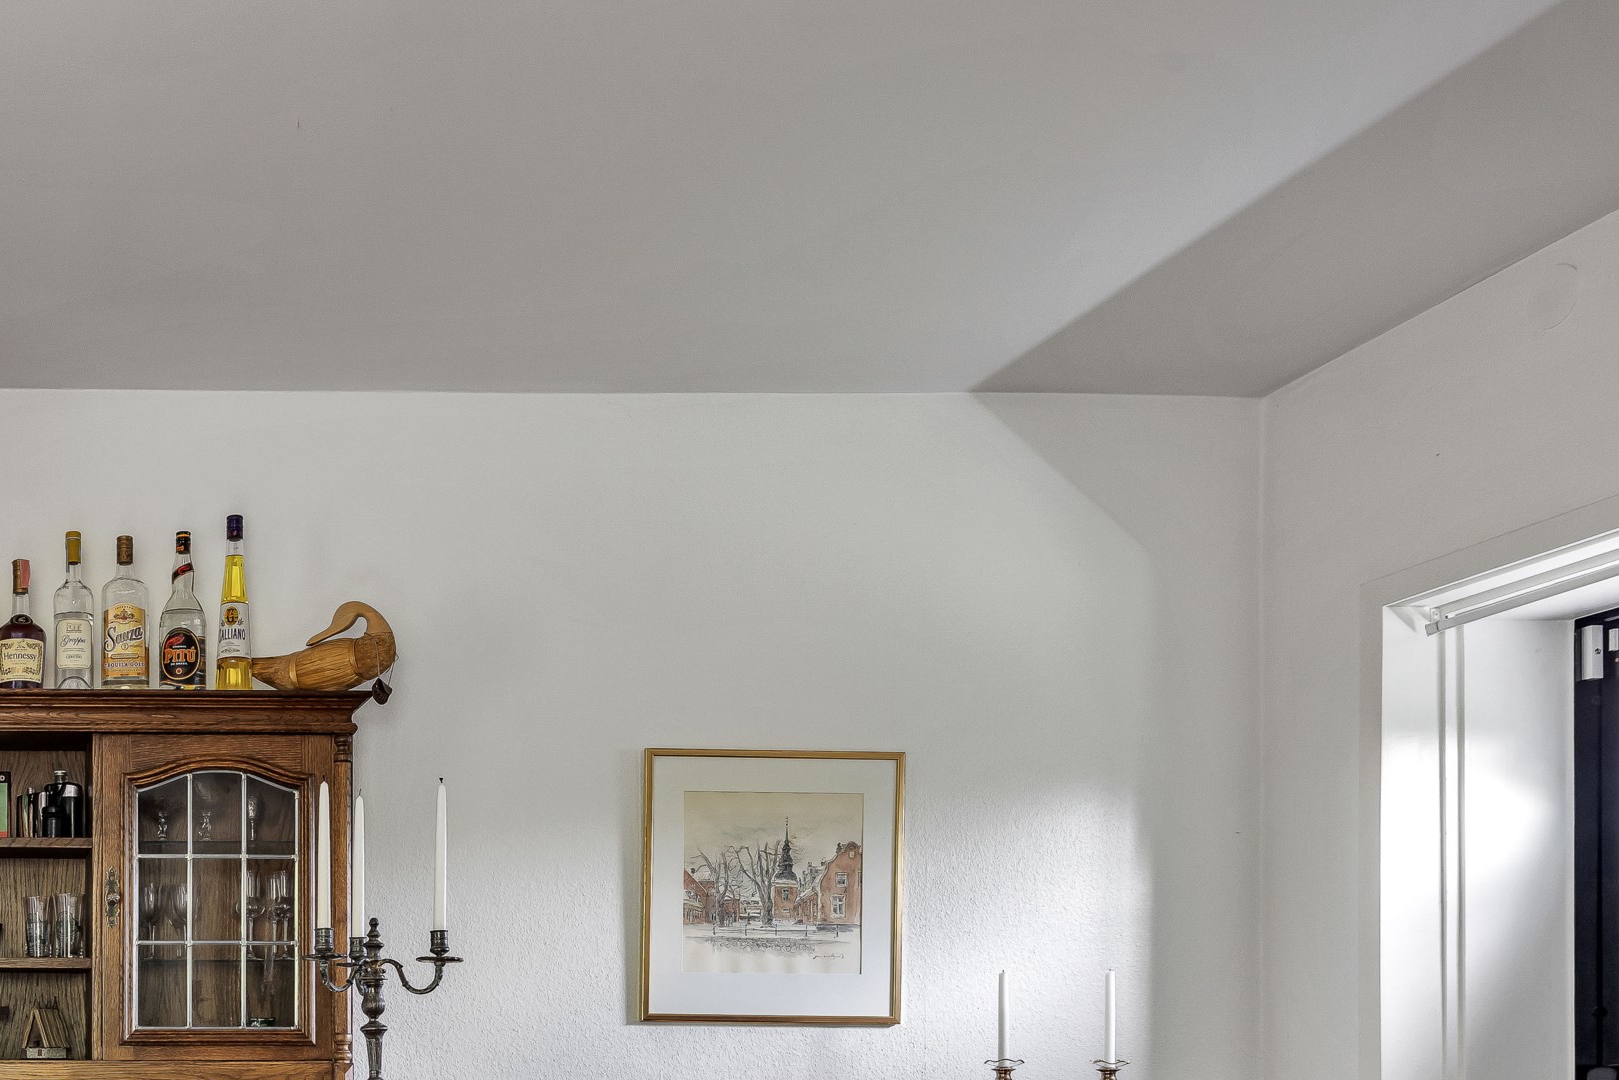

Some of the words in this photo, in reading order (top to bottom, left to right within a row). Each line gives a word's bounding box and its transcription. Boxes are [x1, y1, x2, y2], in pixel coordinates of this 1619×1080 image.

[60, 635, 86, 647] Grappa
[103, 626, 143, 652] Sauza
[3, 652, 37, 662] Hennessy
[164, 646, 197, 664] PITÚ
